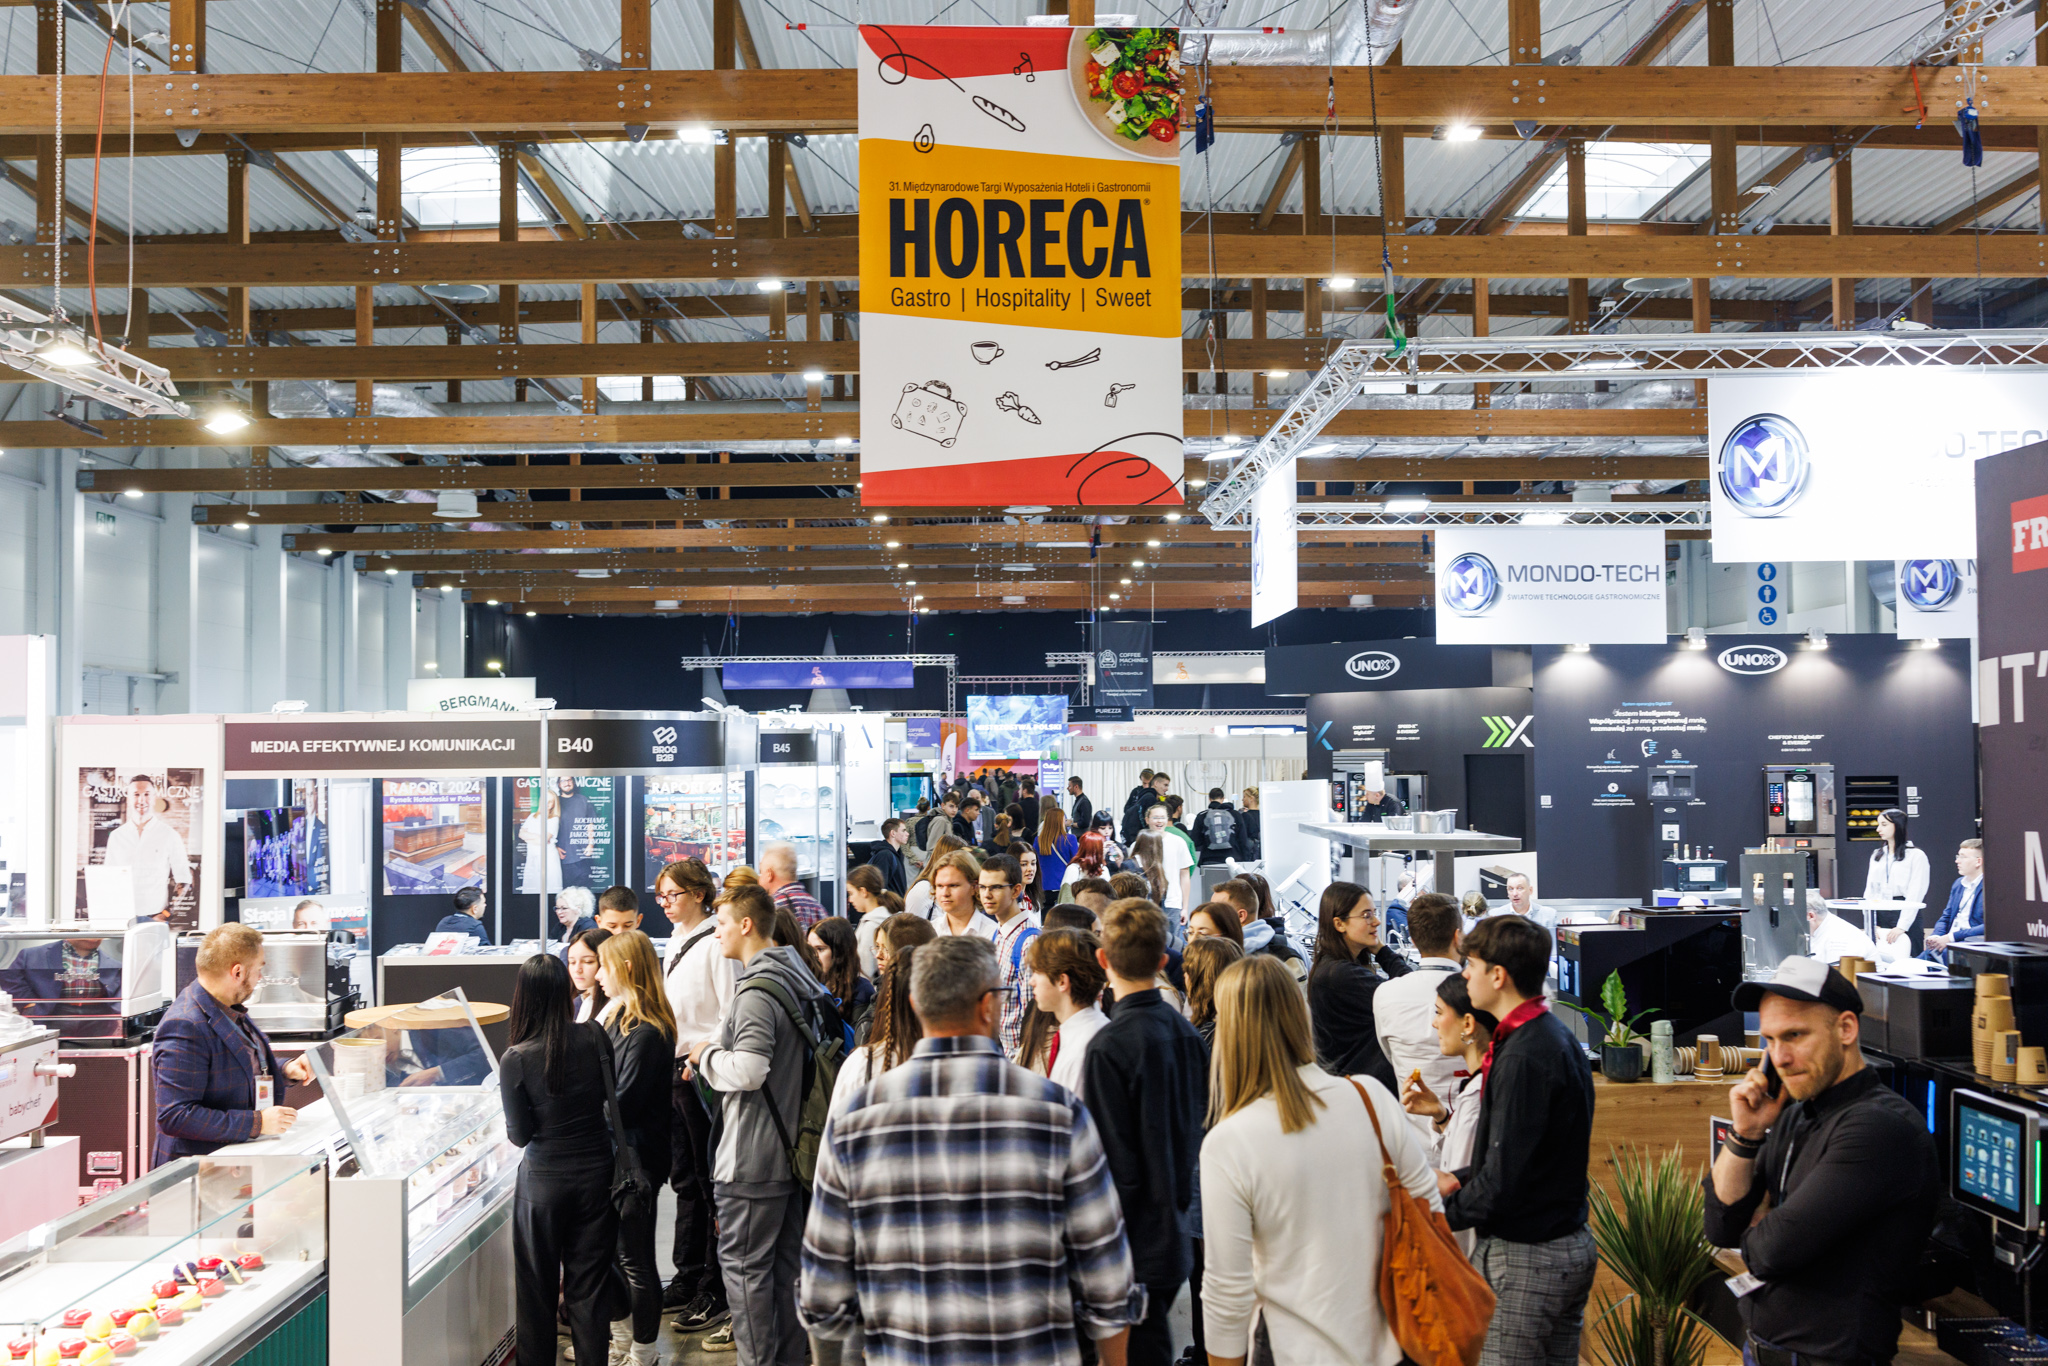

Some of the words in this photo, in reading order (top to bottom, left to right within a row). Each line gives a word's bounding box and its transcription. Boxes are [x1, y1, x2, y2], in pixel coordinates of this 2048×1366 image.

[889, 181, 902, 192] 31.
[903, 181, 979, 194] Międzynarodowe
[980, 182, 1002, 194] Targi
[1003, 182, 1063, 194] Wyposażenia
[1065, 182, 1090, 193] Hoteli
[1096, 182, 1151, 193] Gastronomii
[891, 288, 951, 307] Gastro
[976, 288, 1071, 311] Hospitality
[1096, 288, 1151, 307] Sweet
[1507, 564, 1660, 583] MONDO-TECH
[1507, 592, 1544, 601] ŚWIATOWE
[1545, 592, 1594, 601] TECHNOLOGIE
[1595, 592, 1660, 601] GASTRONOMICZNE
[440, 694, 519, 712] BERGMAN
[1589, 717, 1631, 725] Współpracuj
[1657, 717, 1688, 725] wytrenuj
[1652, 724, 1686, 732] przetestuj
[250, 740, 300, 753] MEDIA
[302, 739, 406, 753] EFEKTYWNEJ
[409, 738, 515, 752] KOMUNIKACJI
[557, 737, 593, 753] B40
[652, 745, 677, 754] BROG
[773, 743, 790, 753] B45
[656, 753, 674, 762] B2B
[388, 781, 444, 795] RAPORT
[447, 780, 481, 794] 2024
[389, 796, 412, 804] Rynek
[2027, 918, 2048, 938] wh
[9, 1093, 41, 1117] babychef
